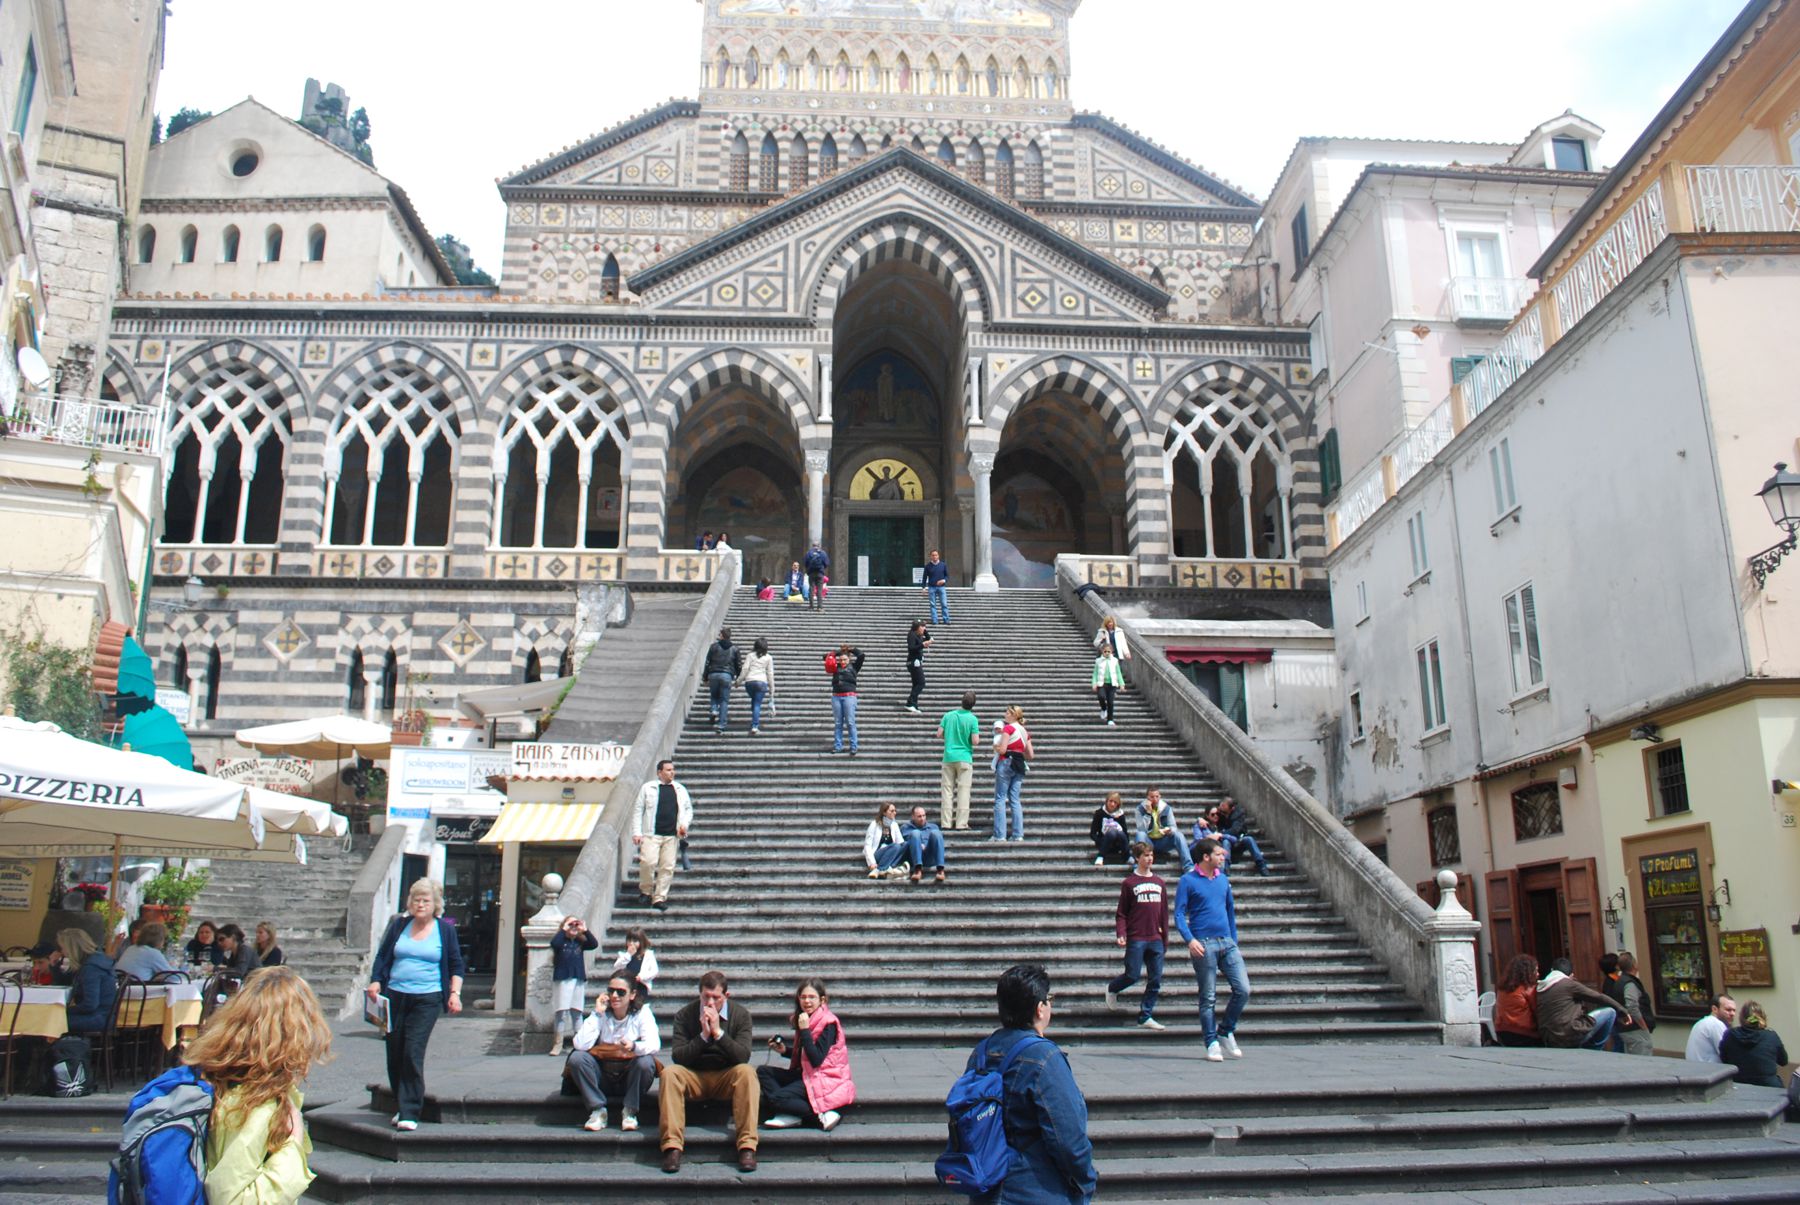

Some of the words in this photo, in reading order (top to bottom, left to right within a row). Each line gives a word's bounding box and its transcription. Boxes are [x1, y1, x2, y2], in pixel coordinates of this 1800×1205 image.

[516, 744, 553, 760] HAIR
[219, 759, 259, 780] TAVERNA
[273, 759, 315, 783] APOSTOLI
[0, 773, 146, 807] PIZZERIA
[436, 824, 473, 842] Bijoux
[1137, 893, 1149, 903] ALL
